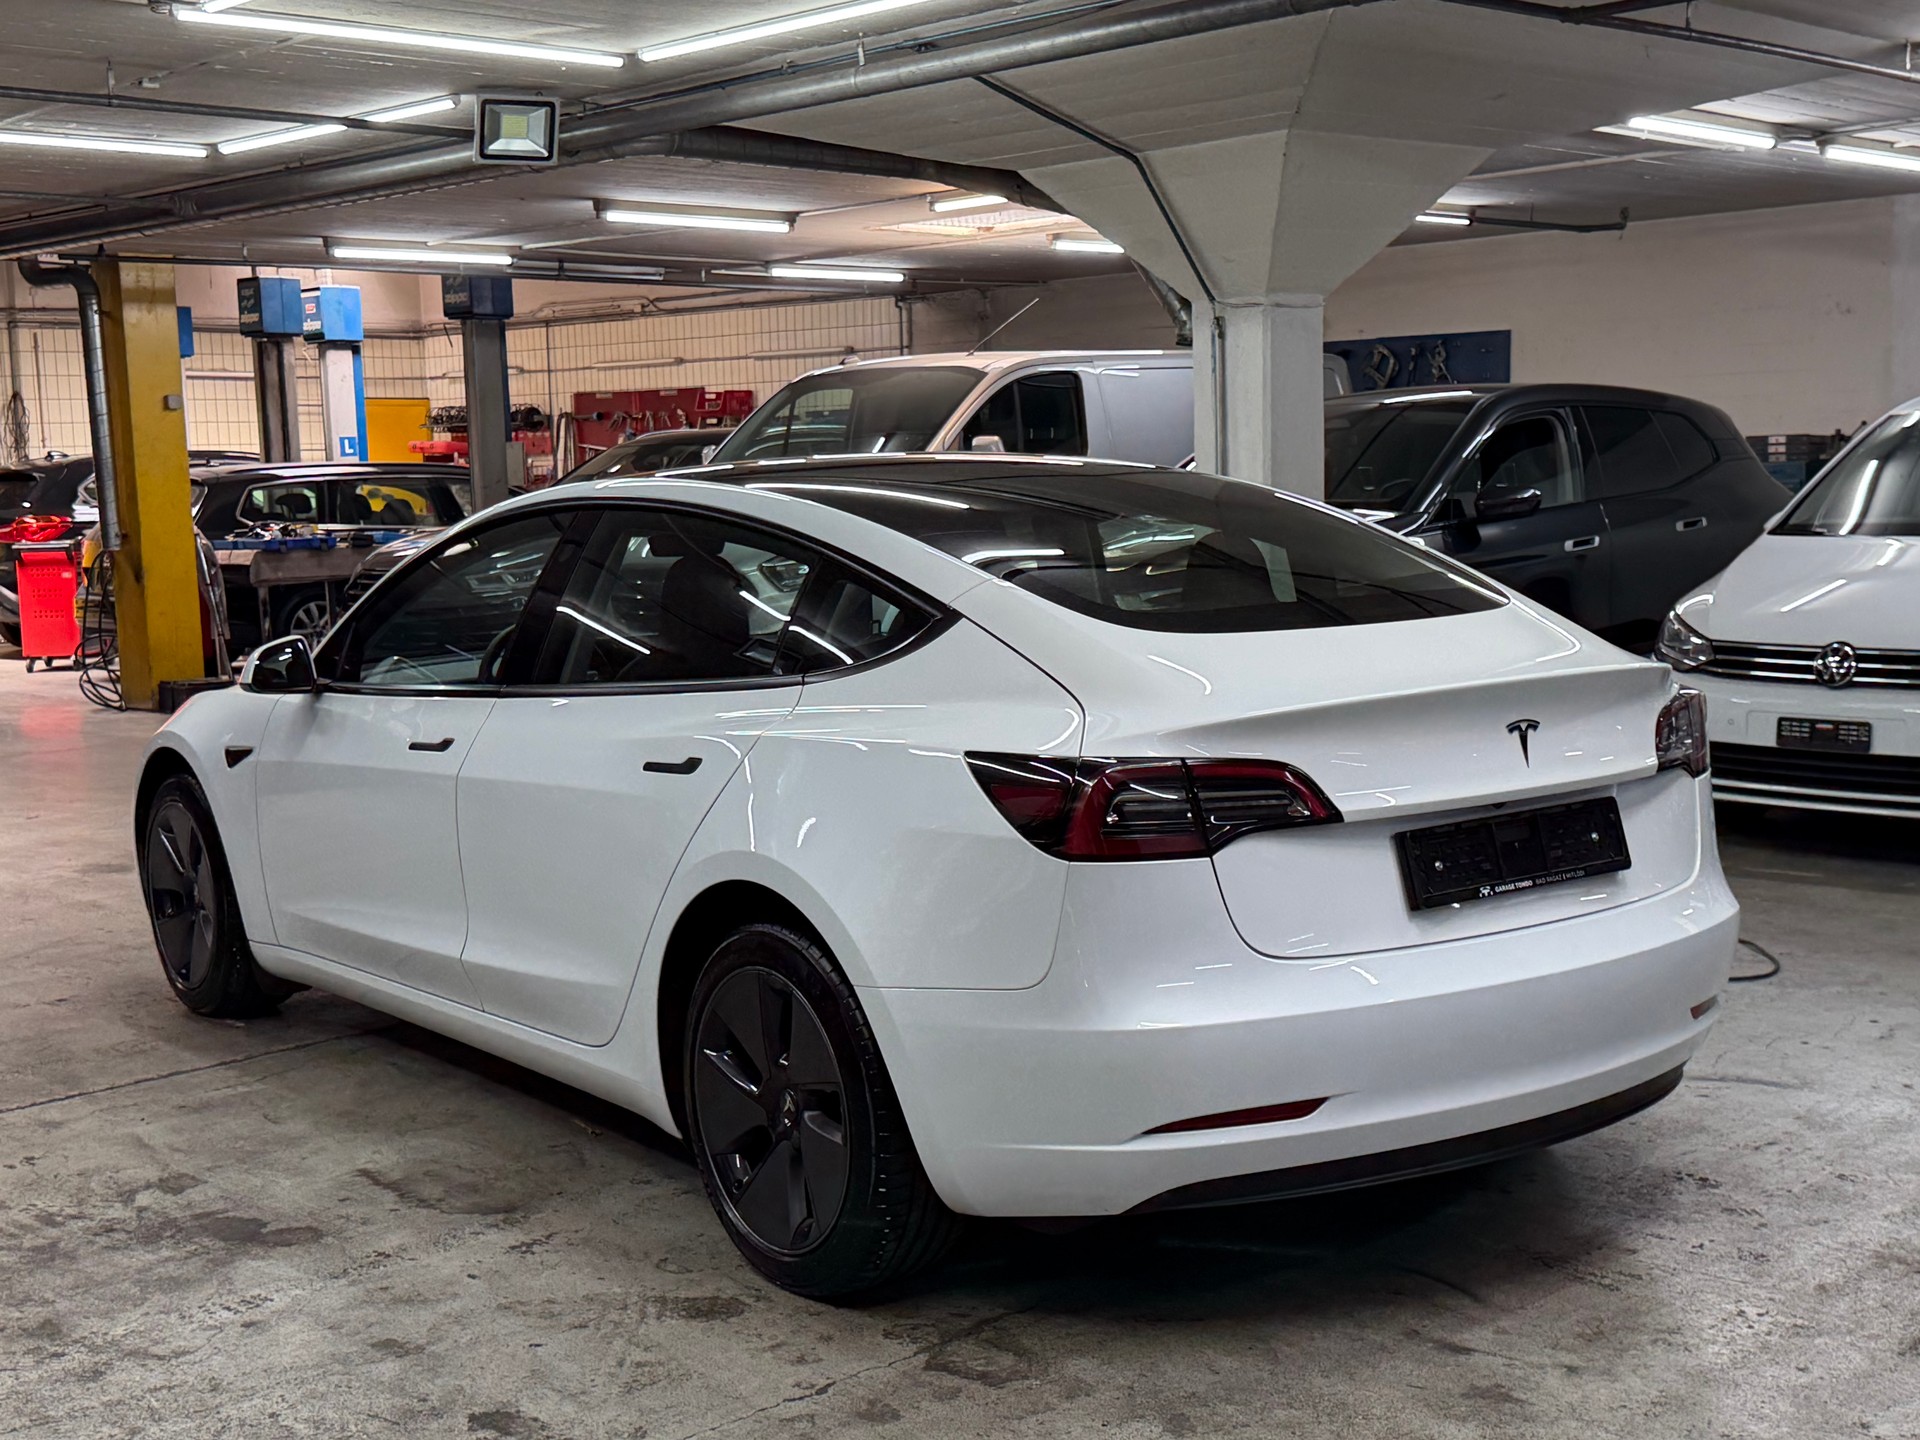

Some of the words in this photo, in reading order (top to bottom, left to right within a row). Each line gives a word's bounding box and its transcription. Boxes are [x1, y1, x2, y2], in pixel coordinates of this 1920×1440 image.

[344, 438, 354, 454] L
[1495, 883, 1515, 892] GARAGE
[1515, 880, 1533, 889] TONDO
